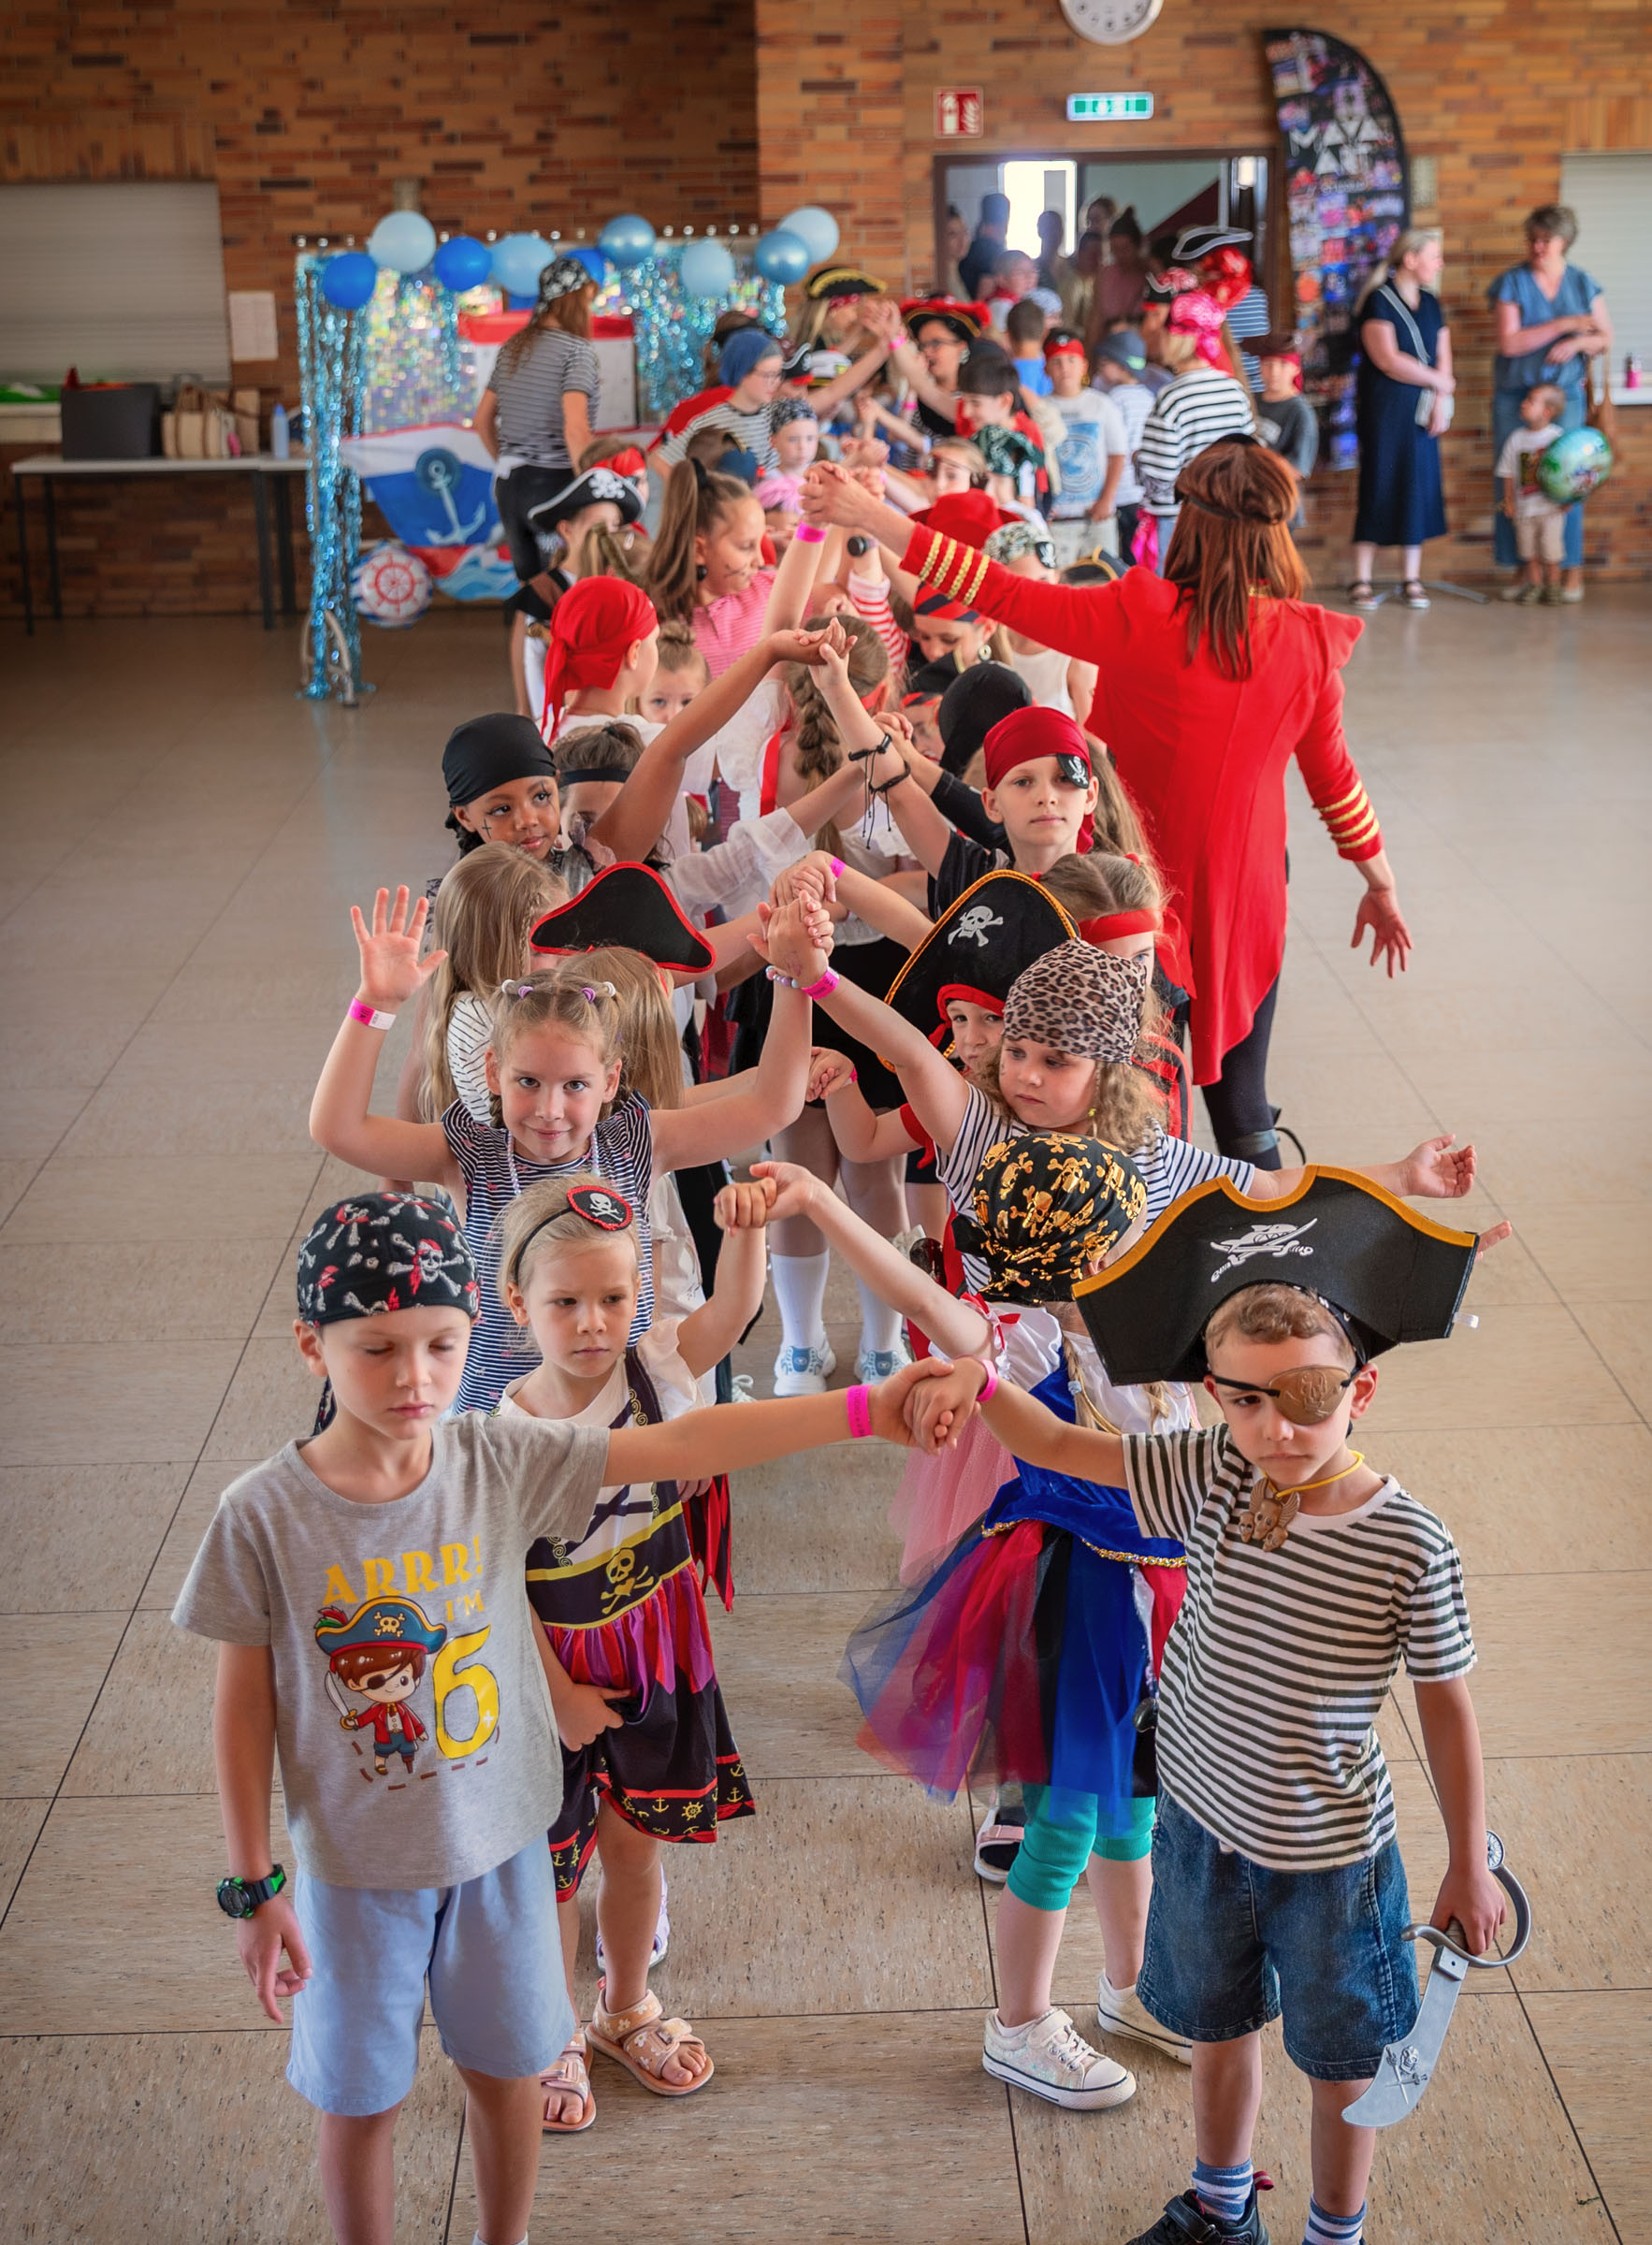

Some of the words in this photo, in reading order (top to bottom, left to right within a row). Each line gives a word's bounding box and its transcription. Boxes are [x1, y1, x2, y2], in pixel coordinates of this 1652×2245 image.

[322, 1534, 483, 1605] ARRR!
[445, 1589, 485, 1622] I'M
[433, 1624, 500, 1760] 6
